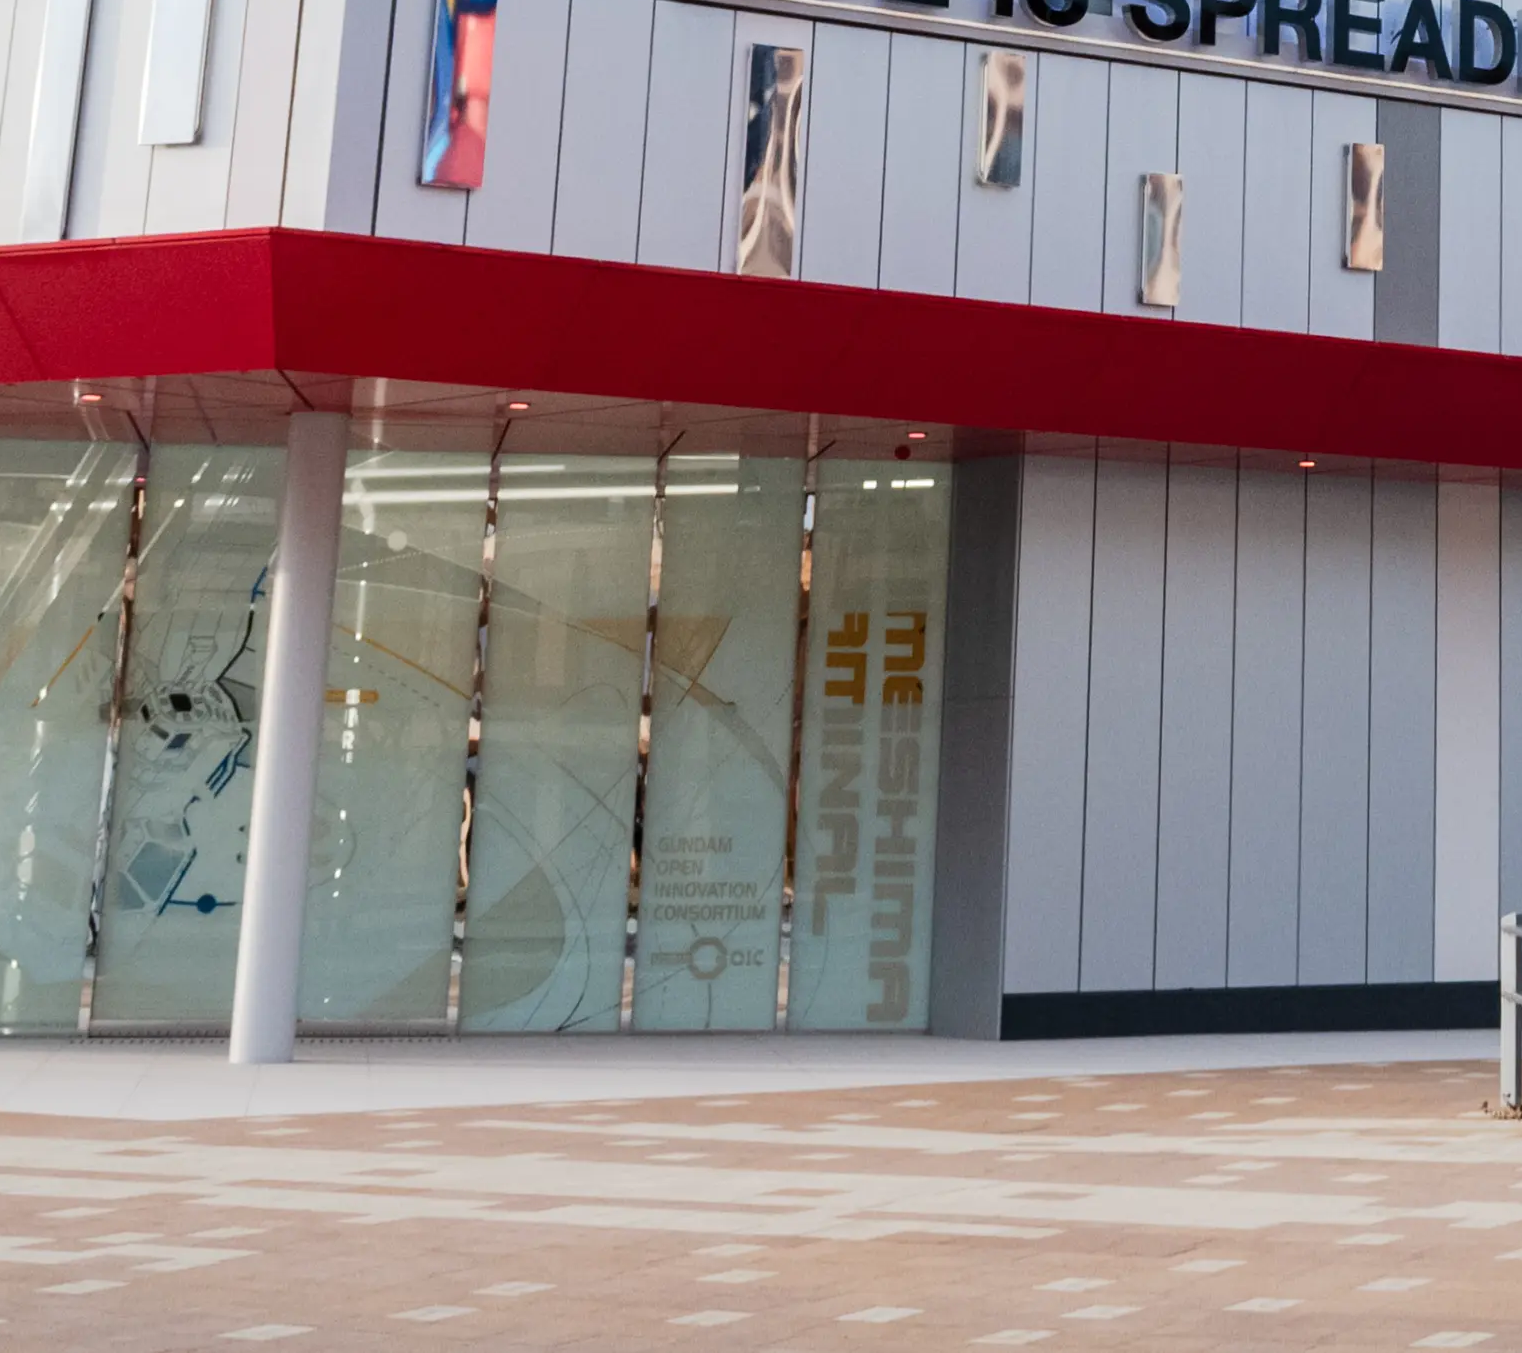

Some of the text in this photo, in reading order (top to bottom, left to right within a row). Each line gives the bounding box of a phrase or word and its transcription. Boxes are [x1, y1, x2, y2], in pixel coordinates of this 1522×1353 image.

[657, 836, 733, 853] GUNDAM
[656, 859, 704, 876] OPEN
[654, 882, 758, 899] INNOVATION
[654, 904, 767, 921] CONSORTIUM
